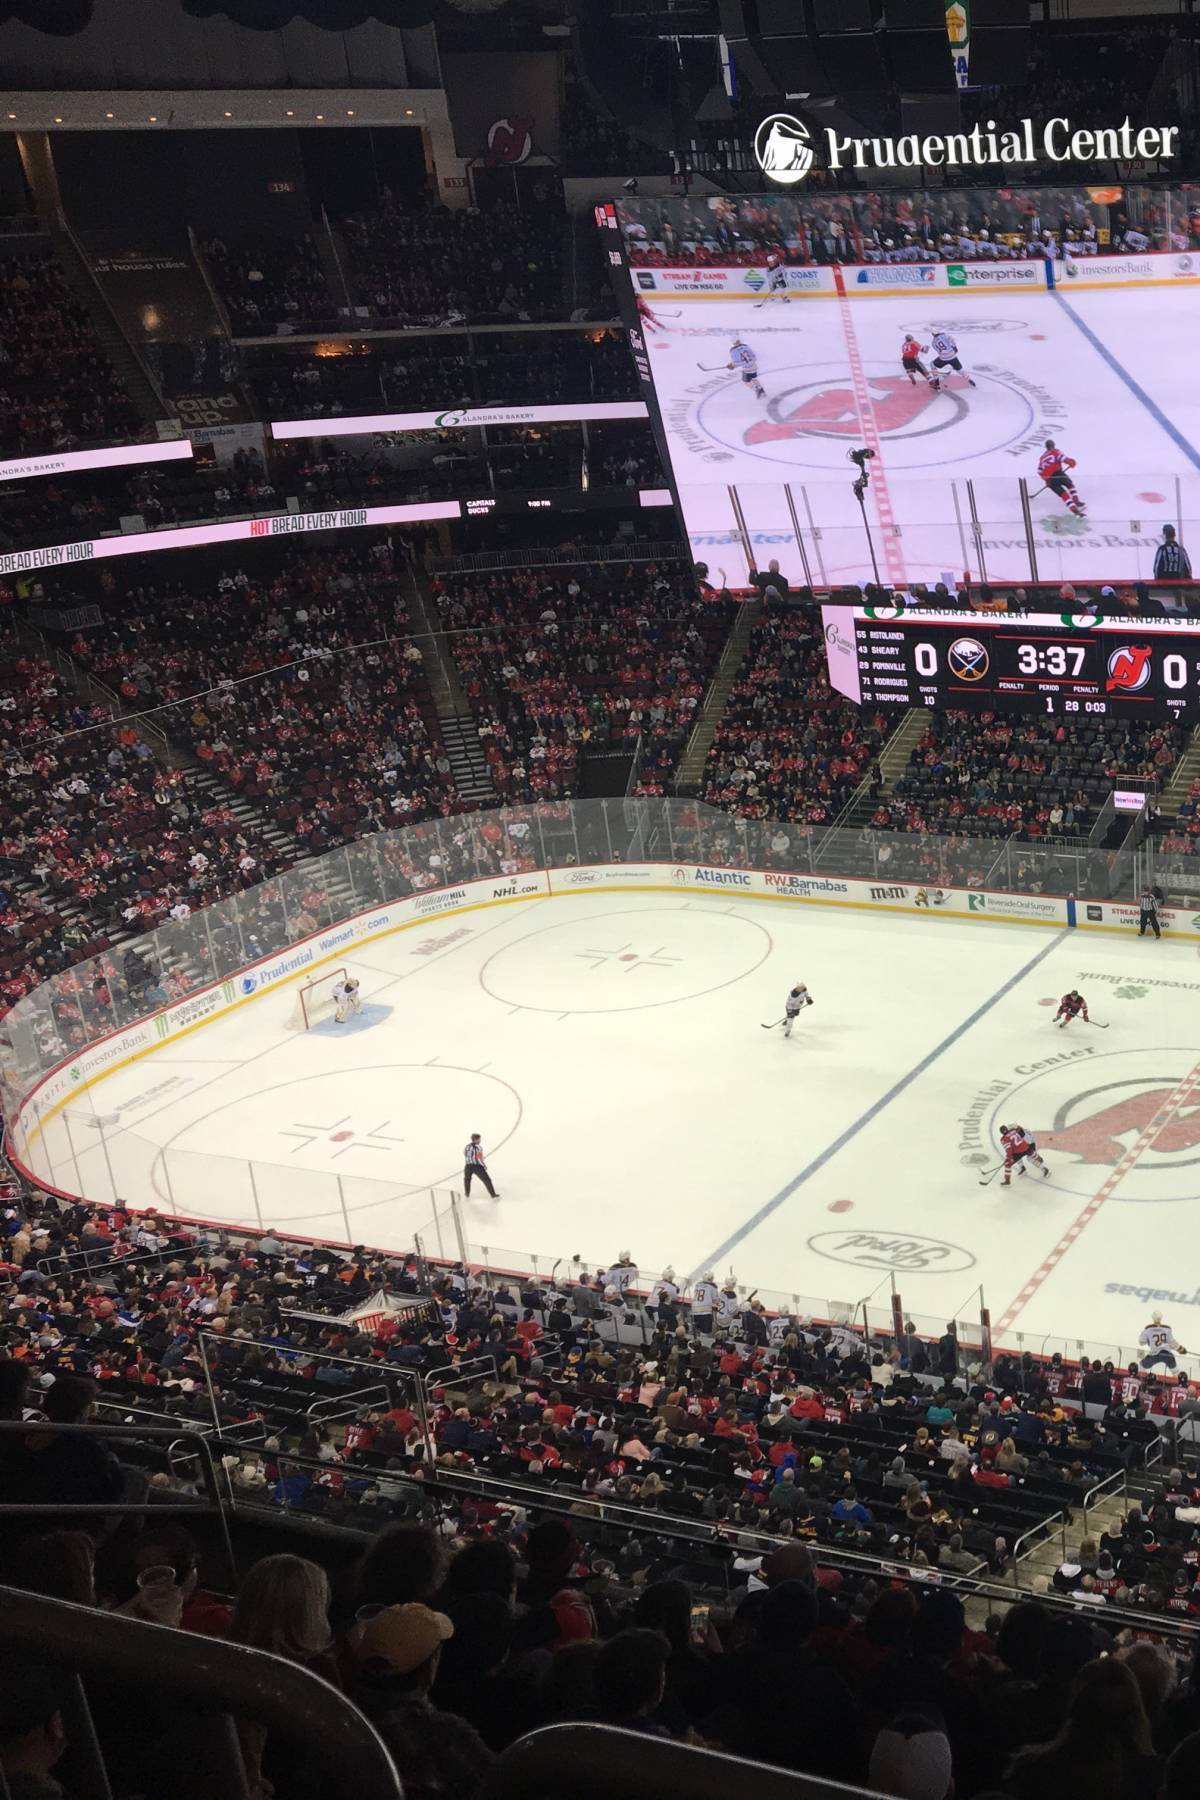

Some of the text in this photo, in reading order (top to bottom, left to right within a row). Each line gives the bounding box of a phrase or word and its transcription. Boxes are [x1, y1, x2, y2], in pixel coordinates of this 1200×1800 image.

[824, 115, 1179, 169] Prudential Center
[272, 183, 290, 192] 134
[113, 263, 153, 271] house
[949, 266, 1035, 284] enterprise
[34, 462, 65, 471] BAKERY
[466, 499, 495, 508] CAPITALS
[468, 507, 489, 515] DUCKS
[250, 510, 367, 536] HOT BREAD EVERY HOUR
[33, 546, 64, 567] EVERY
[66, 542, 94, 561] HOUR
[982, 610, 1030, 620] BAKERY
[856, 630, 867, 638] 55
[858, 646, 868, 654] 43
[871, 646, 900, 656] SHEARY
[859, 661, 869, 669] 29
[915, 643, 938, 677] 0
[1018, 644, 1085, 676] 3:37
[1163, 654, 1188, 689] 0
[862, 677, 871, 685] 71
[999, 682, 1024, 690] PENALTY
[1039, 684, 1060, 692] PERIOD
[1073, 686, 1099, 694] PENALTY
[862, 692, 909, 703] 72 THOMPSON
[924, 696, 935, 705] 10
[1046, 697, 1054, 712] 1
[1065, 701, 1106, 713] 28 0:03
[1174, 710, 1180, 719] 7
[694, 868, 751, 886] Atlantic
[765, 874, 848, 893] RWJBarnabas
[776, 887, 811, 897] HEALTH
[319, 928, 354, 950] Walmart
[260, 949, 312, 985] Prudential
[1014, 1047, 1096, 1075] Center
[959, 1079, 1012, 1152] Prudential
[833, 1234, 951, 1269] Ford
